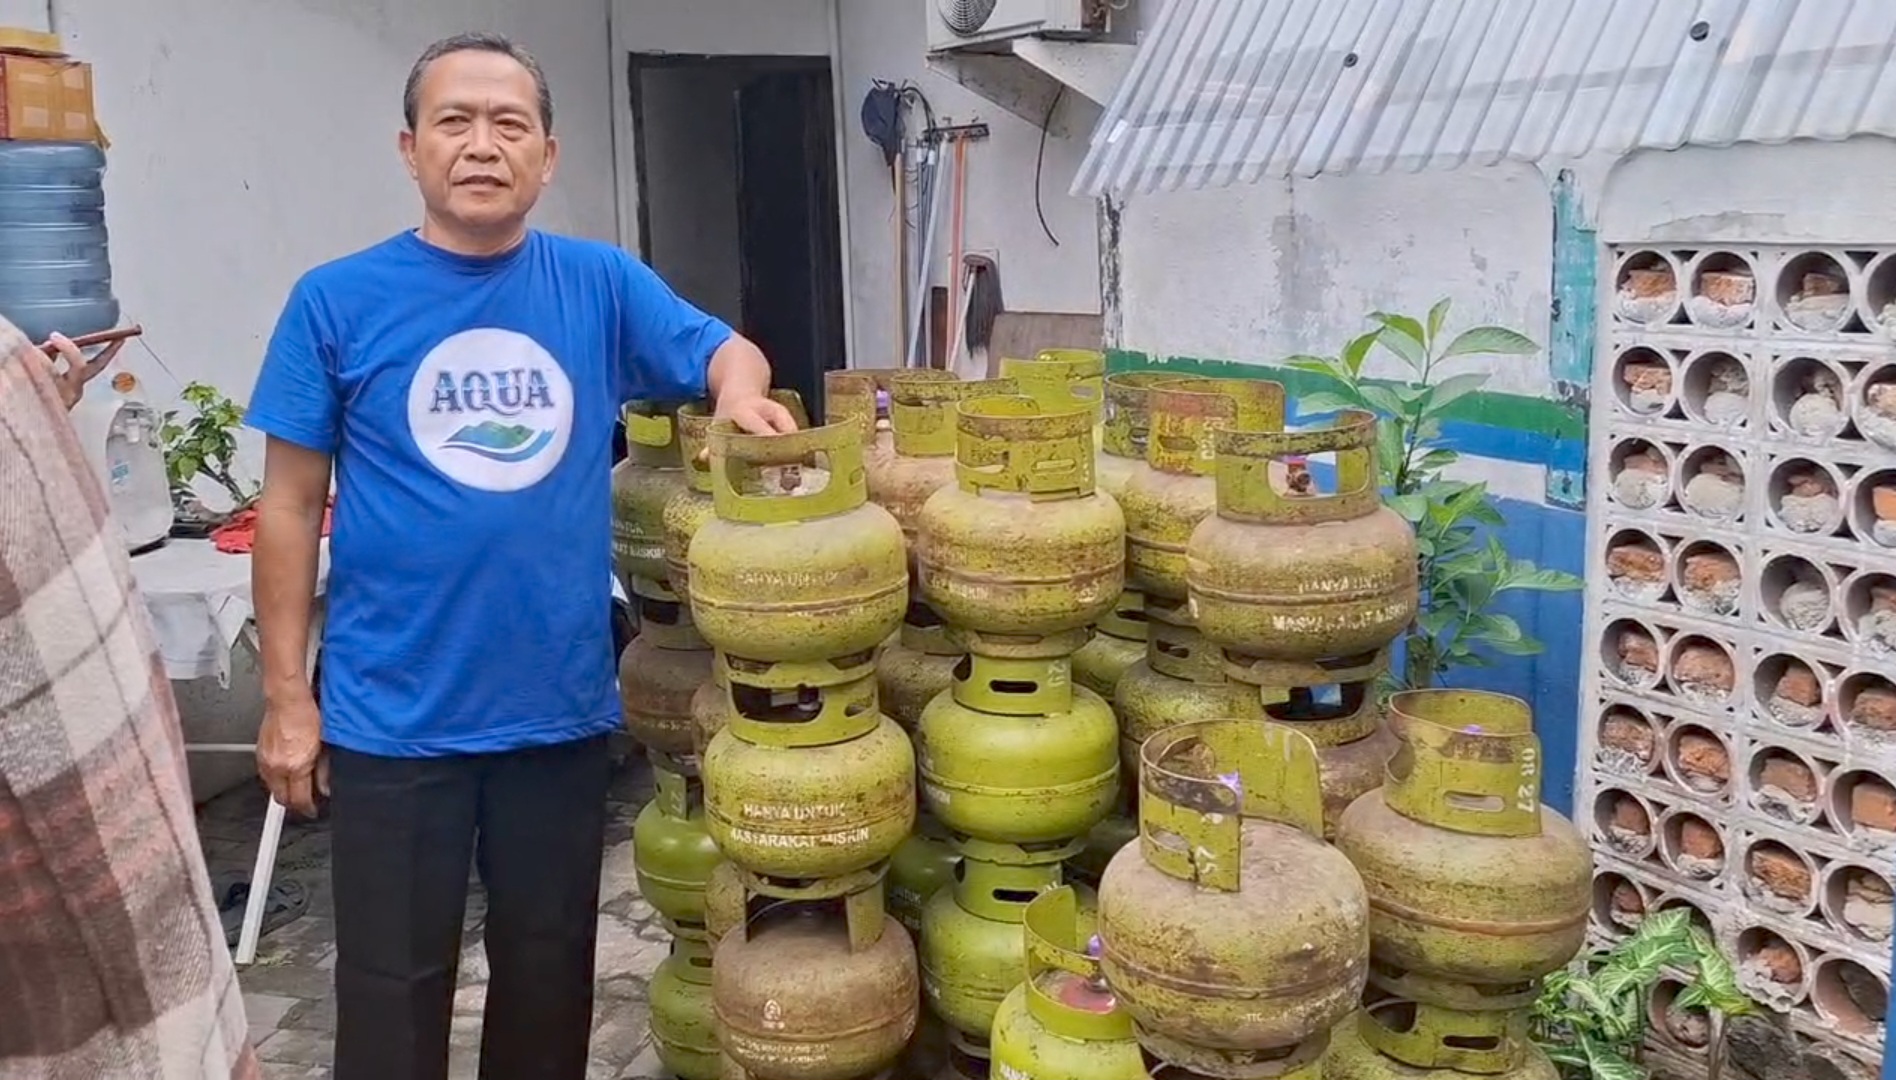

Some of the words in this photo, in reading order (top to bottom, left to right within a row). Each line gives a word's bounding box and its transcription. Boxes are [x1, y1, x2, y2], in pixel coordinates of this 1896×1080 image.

[430, 368, 555, 416] AQUA
[743, 802, 791, 820] HANYA
[793, 802, 846, 820] UNTUK
[1517, 783, 1535, 813] 27
